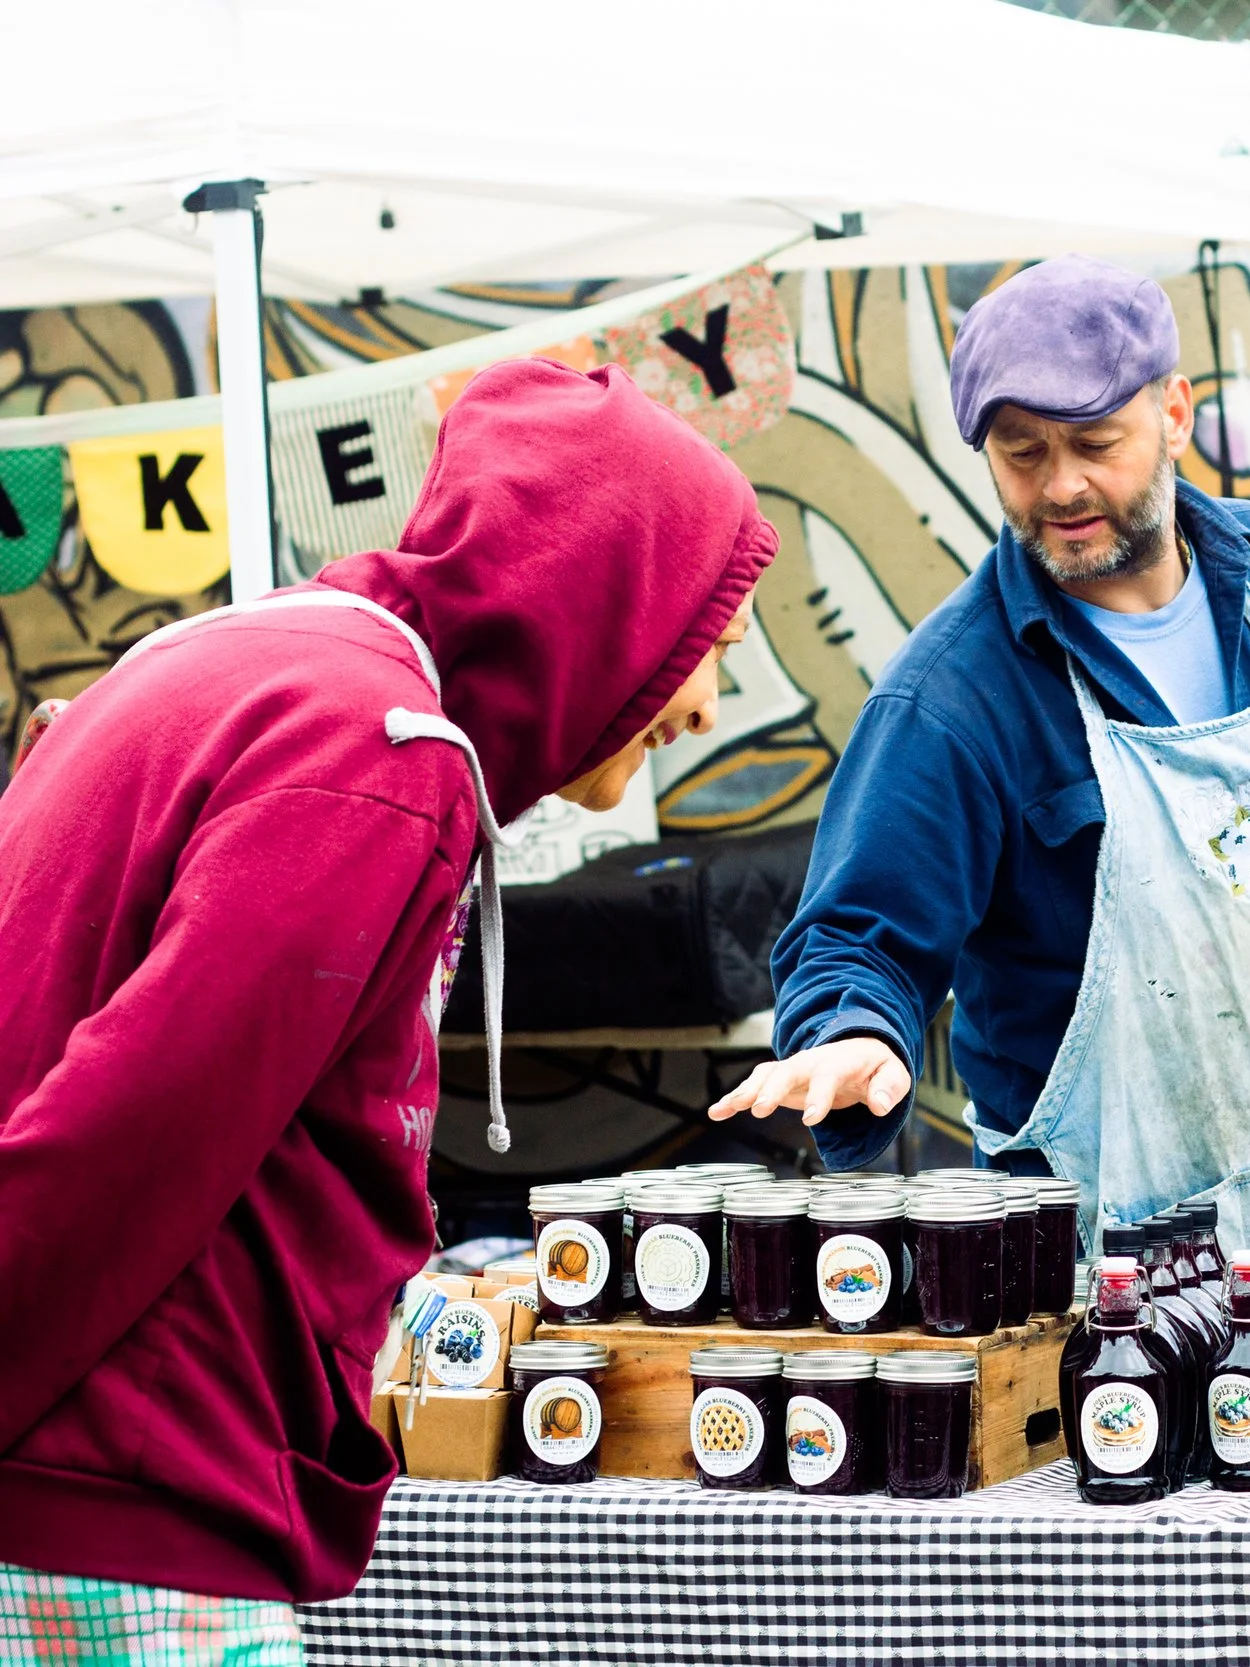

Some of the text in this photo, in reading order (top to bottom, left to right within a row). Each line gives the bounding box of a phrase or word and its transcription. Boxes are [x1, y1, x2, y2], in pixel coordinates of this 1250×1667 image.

[659, 1233, 695, 1250] BLUEBERRY
[846, 1245, 877, 1262] BLUEBERRY
[454, 1309, 486, 1325] BLUEBERRY
[437, 1314, 486, 1340] RAISINS
[1106, 1391, 1142, 1404] BLUEBERRY
[1212, 1389, 1232, 1408] MAPLE
[803, 1407, 830, 1427] BLUEBERRY
[1091, 1397, 1146, 1419] MAPLE SYRUP
[712, 1398, 746, 1414] BLUEBERRY
[744, 1414, 754, 1452] PRESERVES
